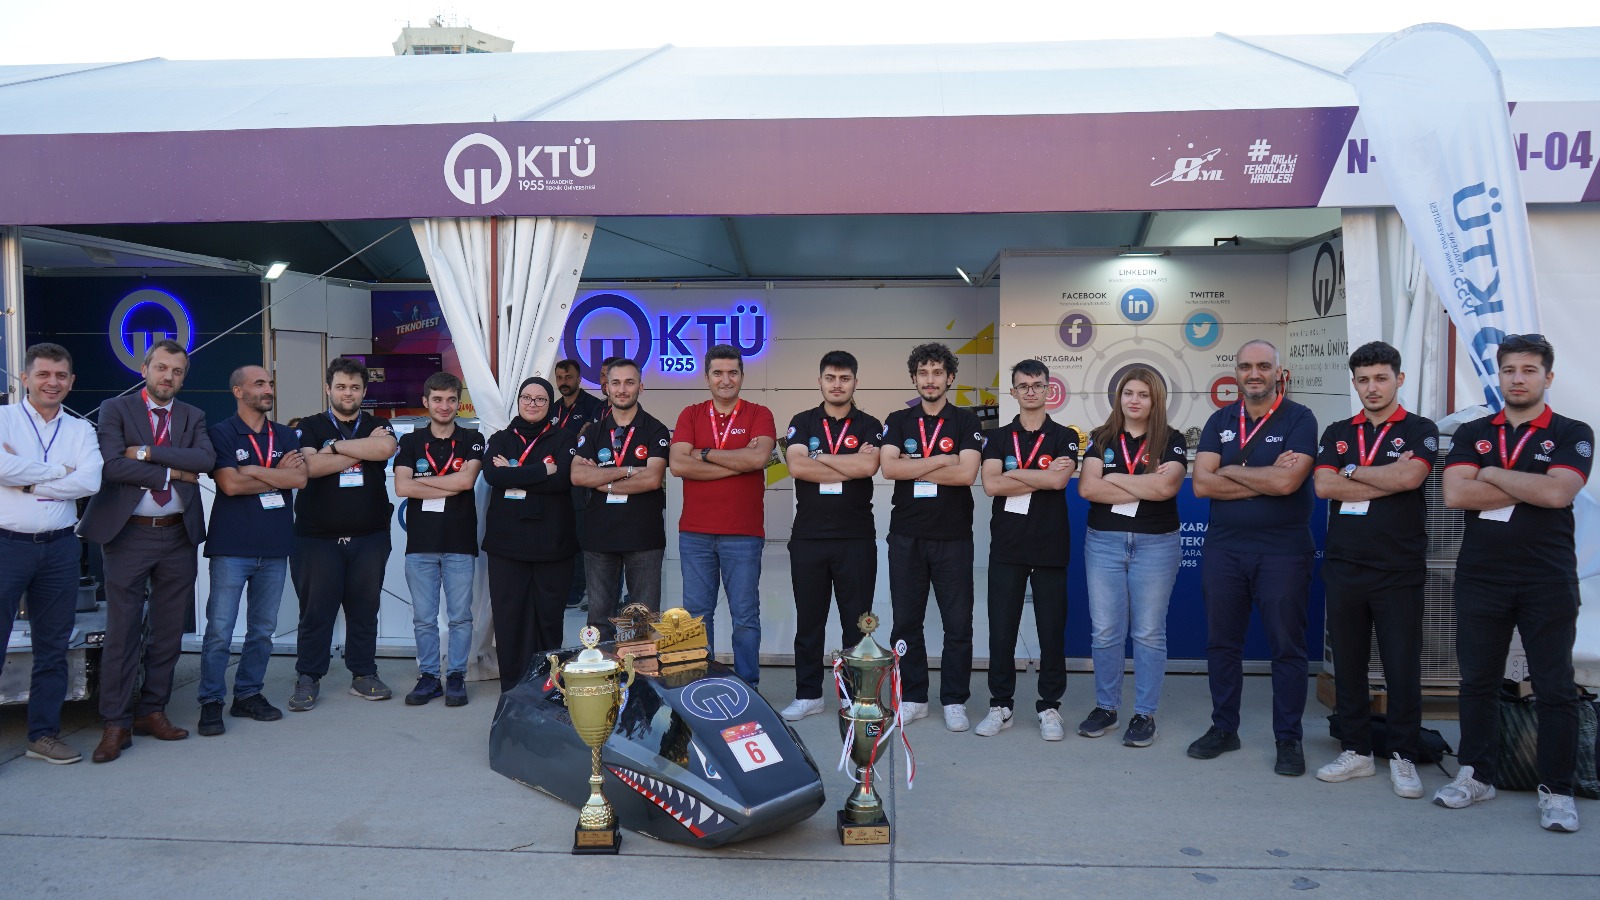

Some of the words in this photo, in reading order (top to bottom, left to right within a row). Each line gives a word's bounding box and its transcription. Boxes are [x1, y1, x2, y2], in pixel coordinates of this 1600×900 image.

[517, 137, 596, 178] KTÜ
[518, 179, 545, 191] 1955
[1118, 268, 1157, 276] LINKEDIN
[1062, 292, 1107, 300] FACEBOOK
[1189, 291, 1225, 299] TWITTER
[395, 316, 440, 335] TEKNOFEST
[659, 304, 765, 357] KTÜ
[1327, 339, 1349, 357] ÜNİVE
[659, 357, 695, 372] 1955
[744, 740, 767, 764] 6
